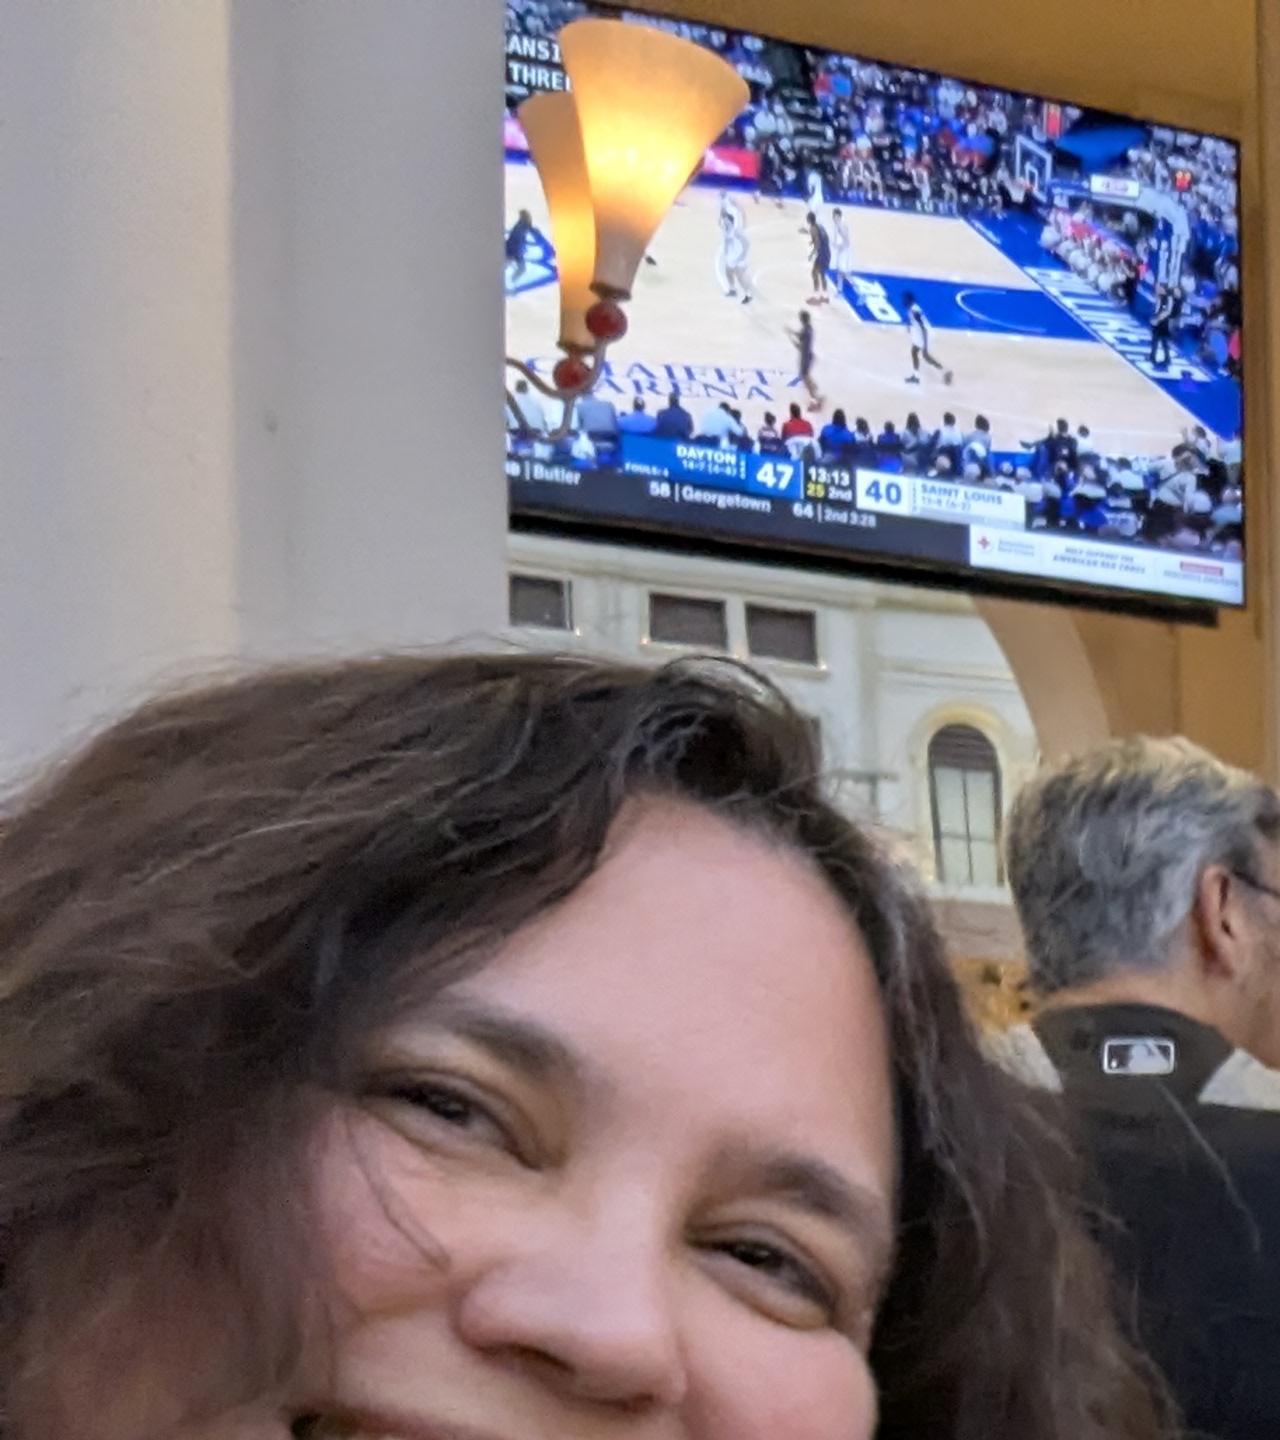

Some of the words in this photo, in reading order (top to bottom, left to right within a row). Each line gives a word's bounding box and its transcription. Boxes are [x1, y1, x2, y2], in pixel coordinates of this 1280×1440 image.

[675, 444, 737, 465] DAYTON
[533, 462, 582, 486] Butler
[755, 462, 794, 490] 47
[808, 466, 850, 487] 13:13
[682, 486, 772, 511] Georgetown
[828, 487, 853, 501] 2nd
[864, 479, 902, 505] 40
[920, 483, 960, 499] SAINT
[963, 490, 1004, 507] LOUIS
[792, 502, 815, 519] 64
